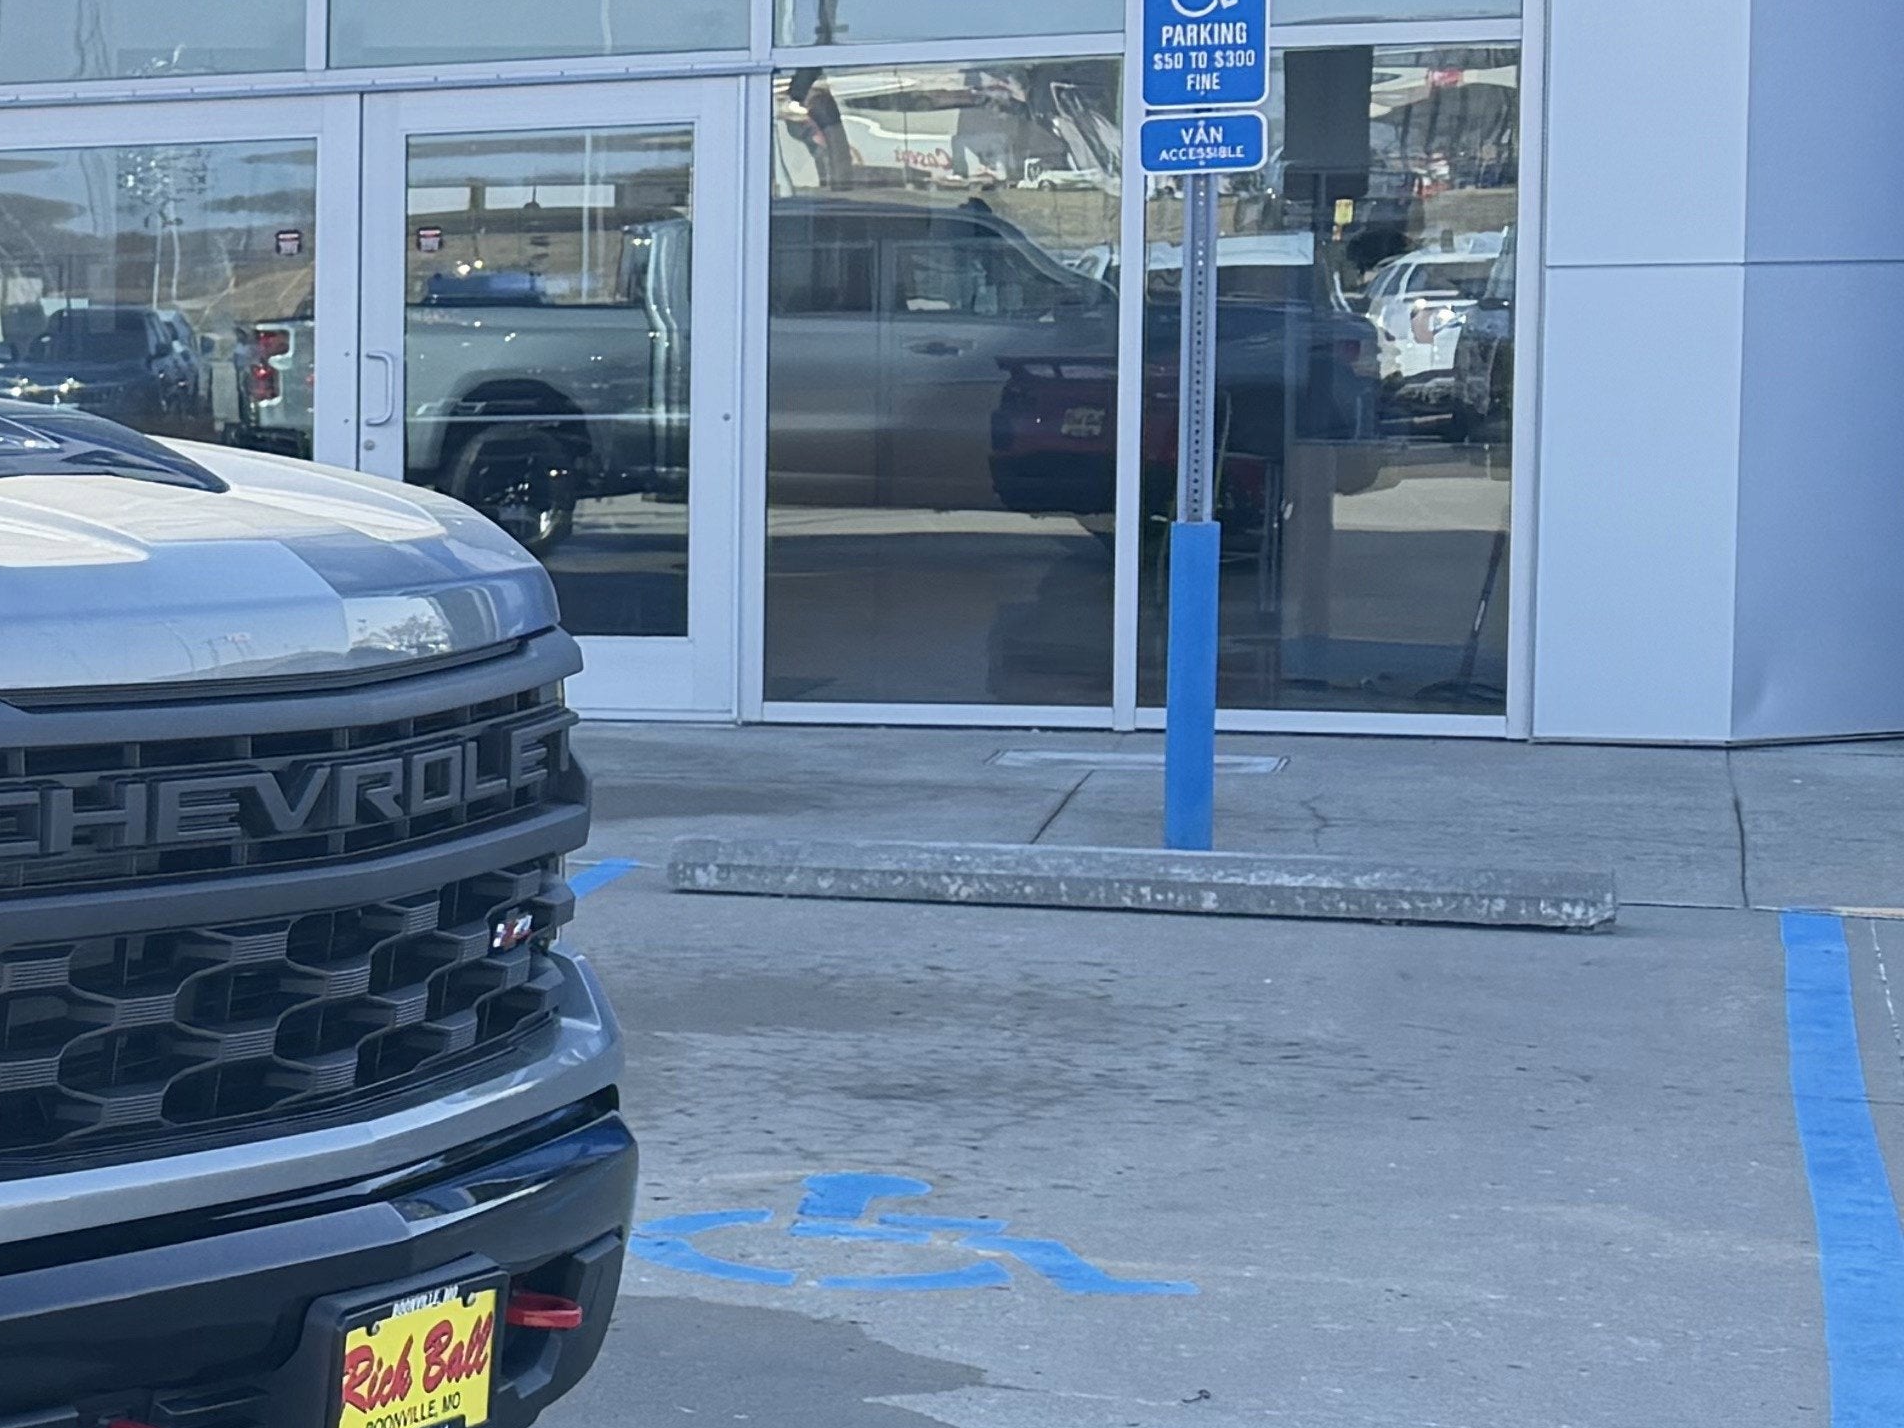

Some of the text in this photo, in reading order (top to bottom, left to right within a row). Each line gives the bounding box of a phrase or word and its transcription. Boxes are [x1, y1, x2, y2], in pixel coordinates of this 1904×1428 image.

[1161, 22, 1248, 46] PARKING
[1153, 49, 1256, 70] $50 TO $300
[1186, 73, 1221, 91] FINE
[1180, 126, 1224, 144] VAN
[1158, 145, 1245, 161] ACCESSIBLE
[343, 1311, 494, 1414] Rick Ball
[441, 1391, 461, 1414] MO
